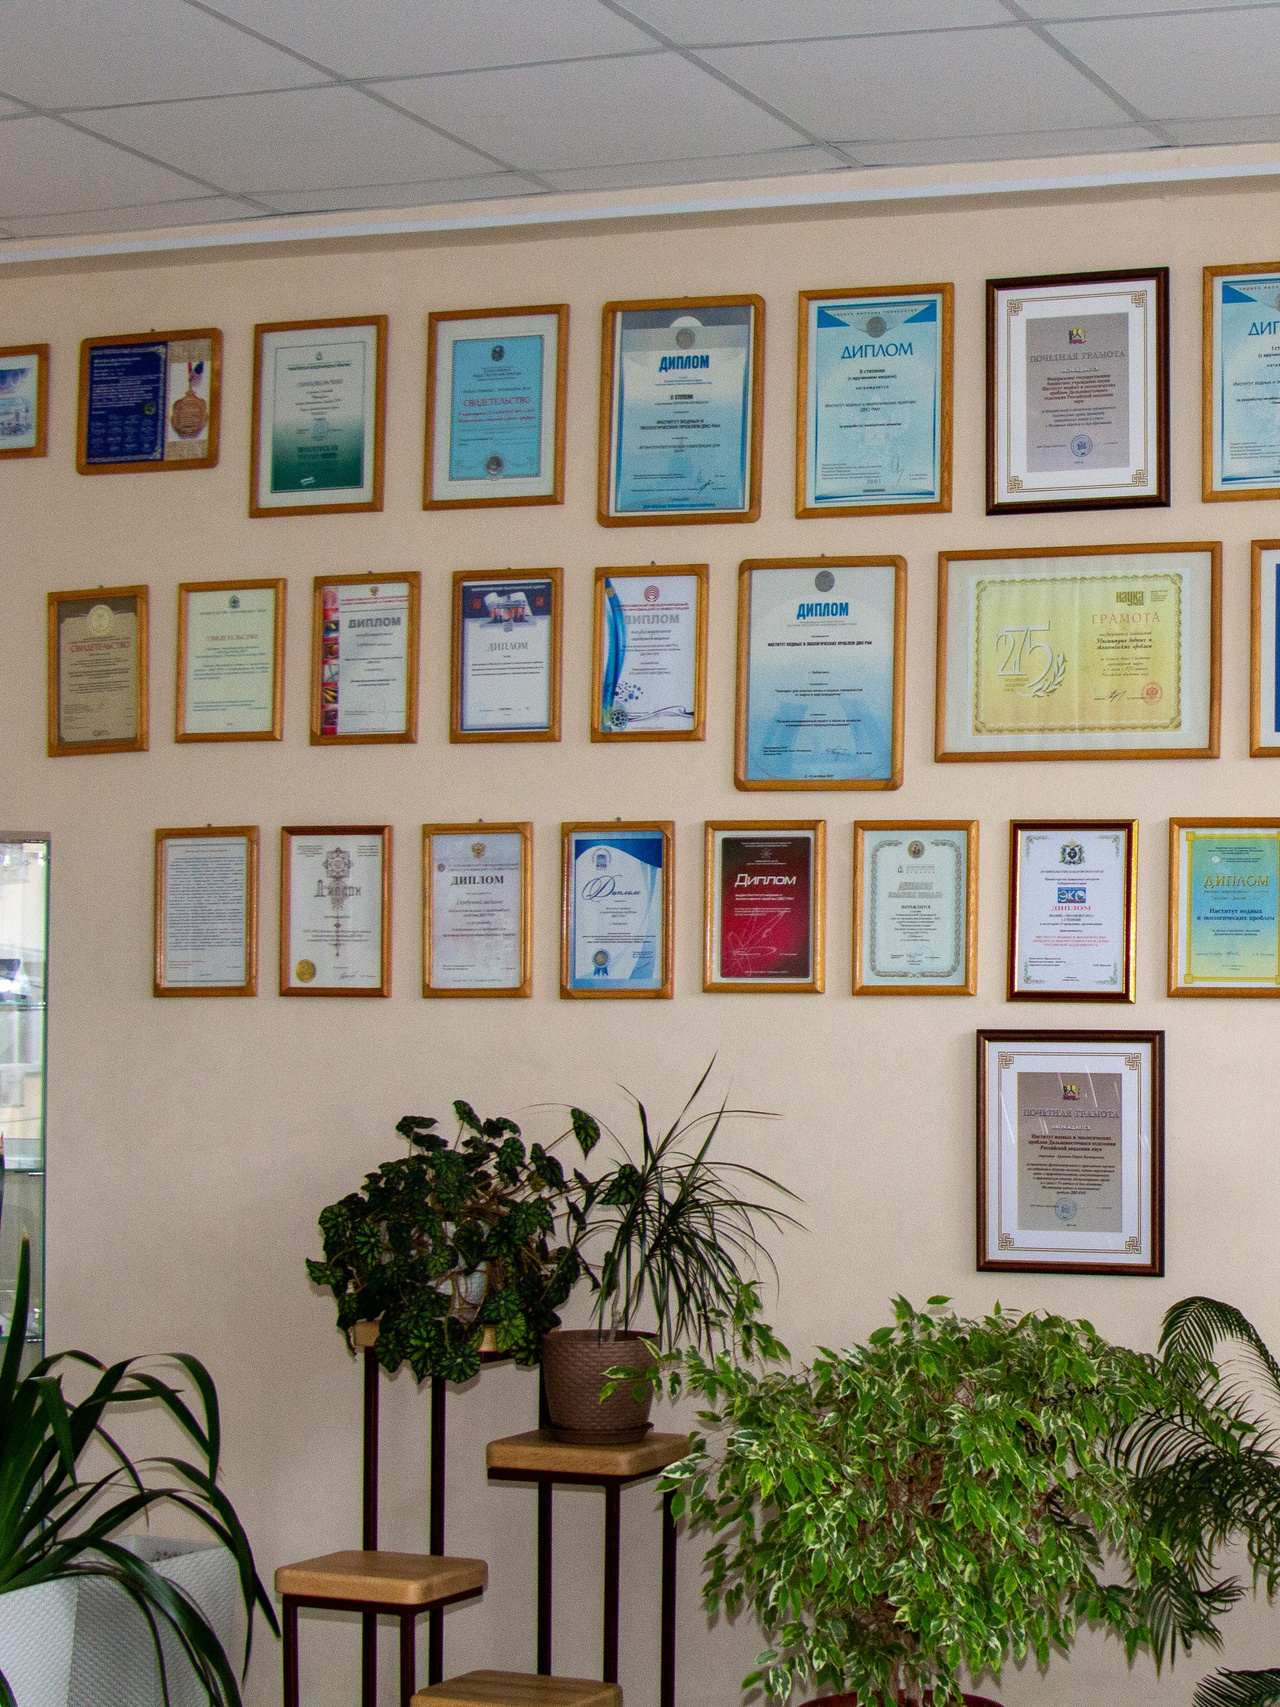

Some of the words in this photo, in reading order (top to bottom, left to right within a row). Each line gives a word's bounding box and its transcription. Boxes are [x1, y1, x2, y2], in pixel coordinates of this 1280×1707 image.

[841, 342, 914, 359] ДИПЛОМ
[1030, 352, 1078, 363] ПОЧЕТНАЯ
[1081, 350, 1126, 360] ГРАМОТА
[659, 354, 710, 373] ДИПЛОМ
[463, 396, 531, 408] СВИДЕТЕЛЬСТВО
[1116, 590, 1144, 607] наука
[796, 602, 849, 620] ДИПЛОМ
[348, 617, 402, 629] ДИПЛОМ
[624, 613, 680, 625] ДИПЛОМ
[1091, 612, 1160, 625] ГРАМОТА
[69, 641, 130, 653] СВИДЕТЕЛЬСТВО
[488, 642, 528, 652] ДИПЛОМ
[451, 875, 504, 886] ДИПЛОМ
[734, 873, 797, 888] Диплом
[1203, 875, 1269, 889] ДИПЛОМ
[582, 874, 642, 902] Диплом
[1058, 890, 1086, 902] ЭКО
[1022, 1108, 1073, 1118] ПОЧЕТНАЯ
[1075, 1109, 1120, 1119] ГРАМОТА
